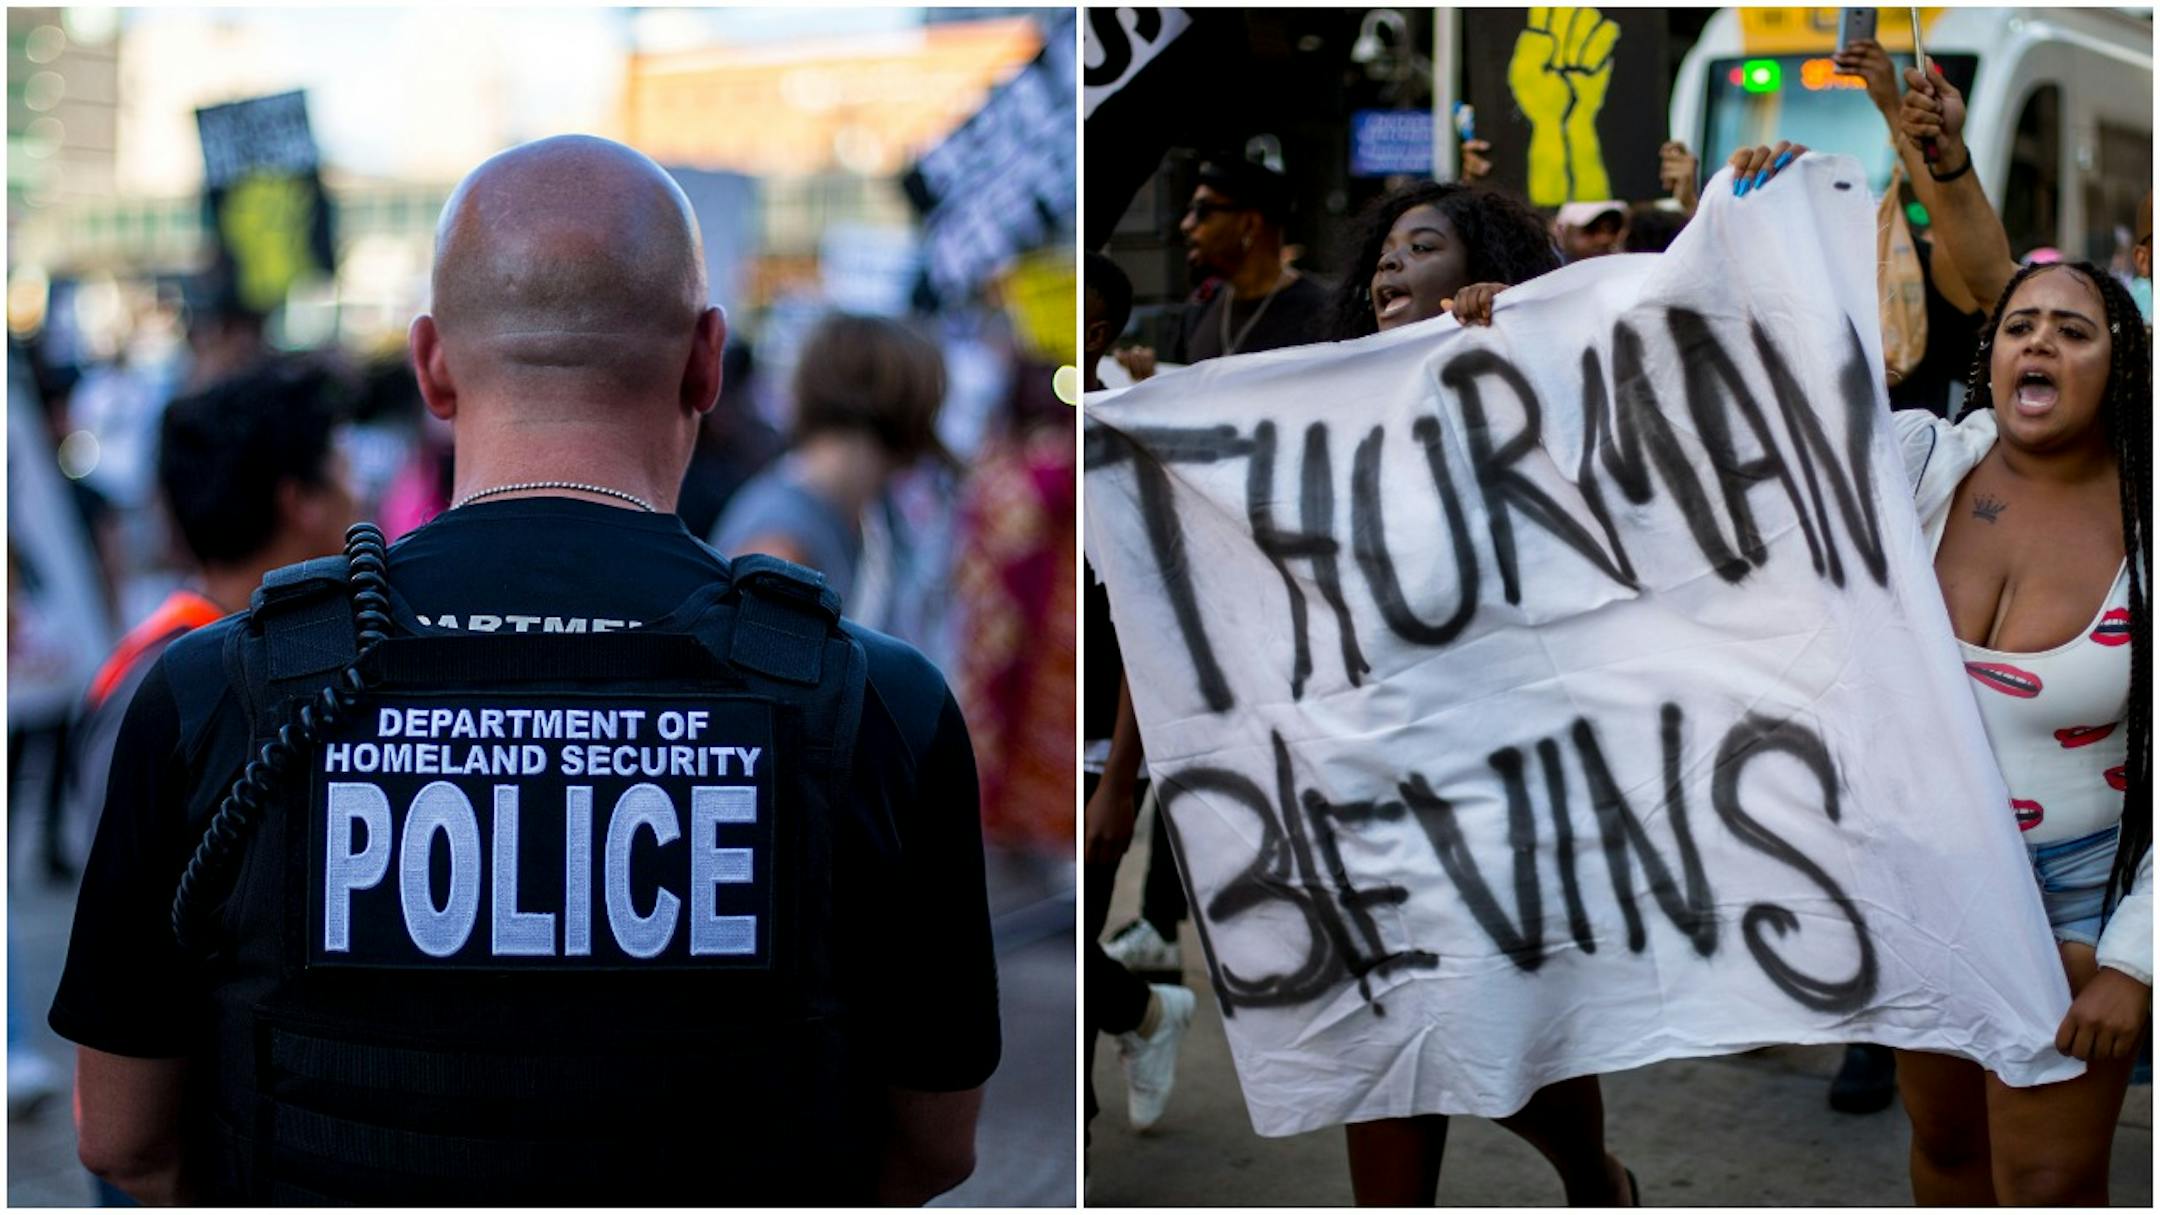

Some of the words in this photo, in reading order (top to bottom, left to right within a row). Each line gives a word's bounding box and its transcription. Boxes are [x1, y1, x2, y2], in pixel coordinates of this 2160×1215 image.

[1084, 304, 1888, 714] THURMAN
[325, 743, 547, 775] HOMELAND
[561, 746, 762, 777] SECURITY
[378, 708, 645, 740] DEPARTMENT
[658, 711, 710, 740] OF
[325, 780, 758, 959] POLICE
[1157, 702, 1878, 1018] BLEVINS
